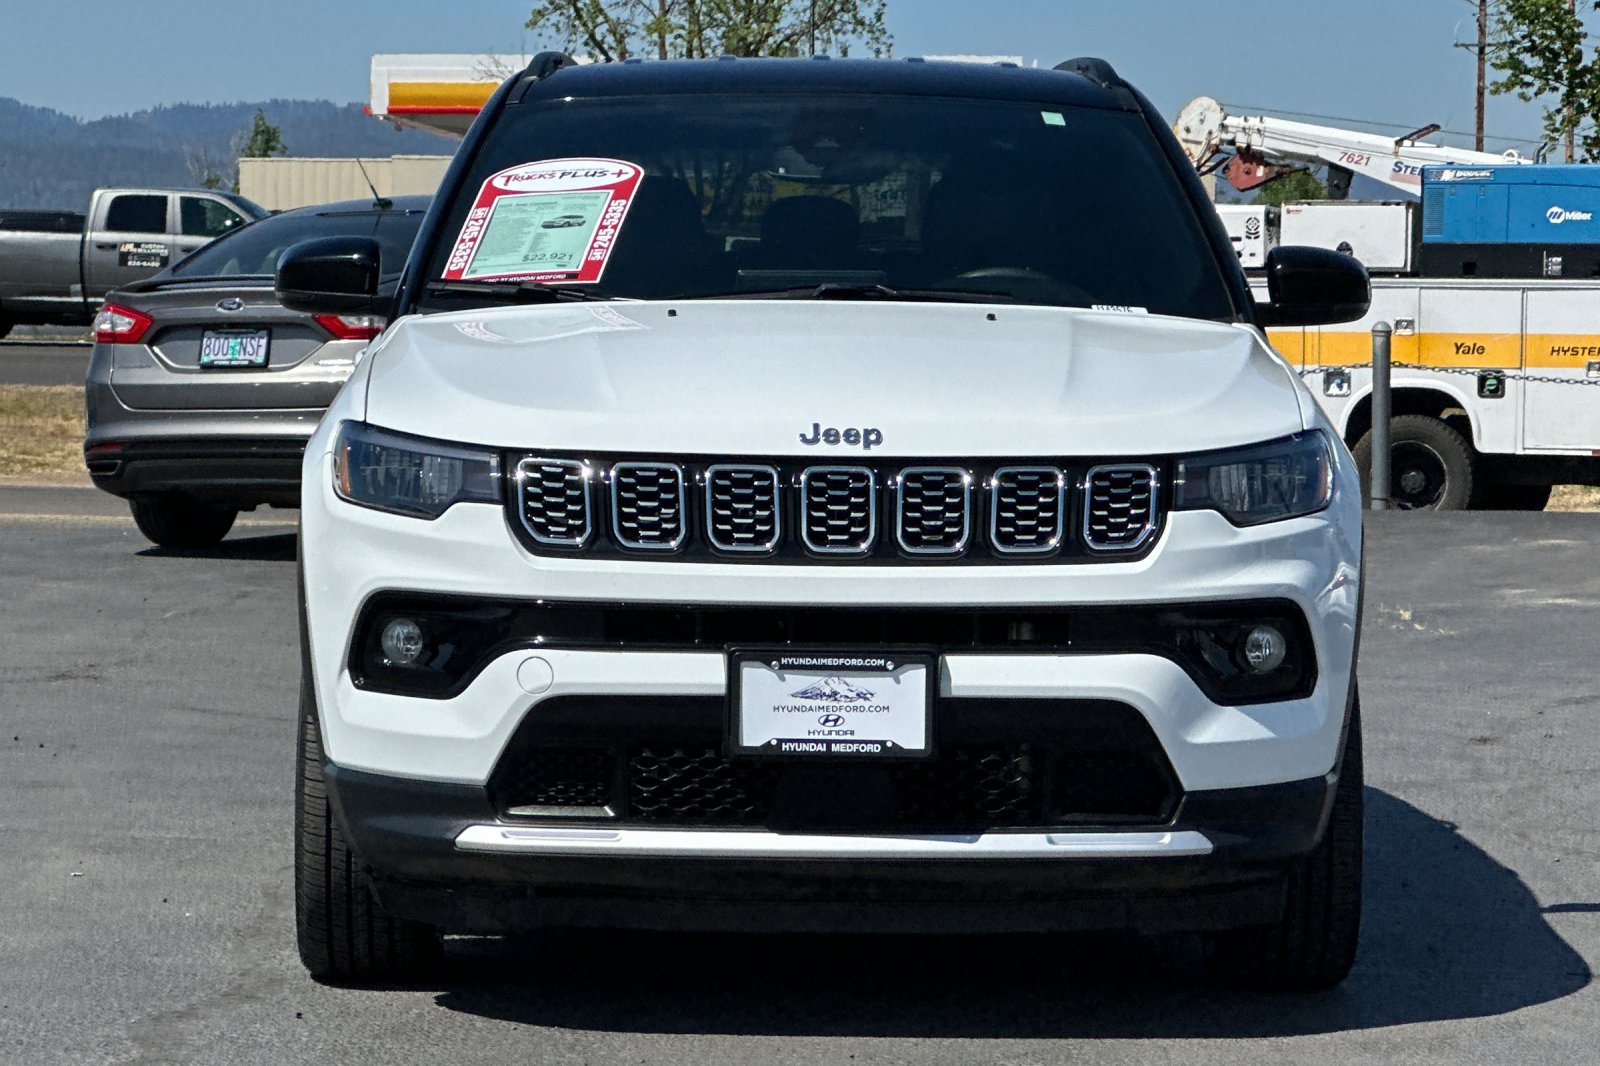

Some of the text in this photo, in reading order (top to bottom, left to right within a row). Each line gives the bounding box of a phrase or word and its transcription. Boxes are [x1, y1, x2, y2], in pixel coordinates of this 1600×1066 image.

[1338, 151, 1371, 167] 7621
[500, 171, 556, 186] TRUCKS
[1564, 211, 1593, 221] Miller
[593, 199, 627, 248] 245-5335
[449, 219, 484, 271] 245-5335
[536, 273, 567, 281] MEDFORD
[203, 336, 266, 357] 800 NSF
[1453, 342, 1486, 355] Yale
[799, 422, 884, 451] Jeep
[781, 657, 885, 667] HYUNDAIMEDFORD.COM
[773, 704, 890, 714] HYUNDAIMEDFORD.COM
[807, 729, 855, 737] HYUNDAI
[781, 742, 881, 753] HYUNDAI MEDFORD
